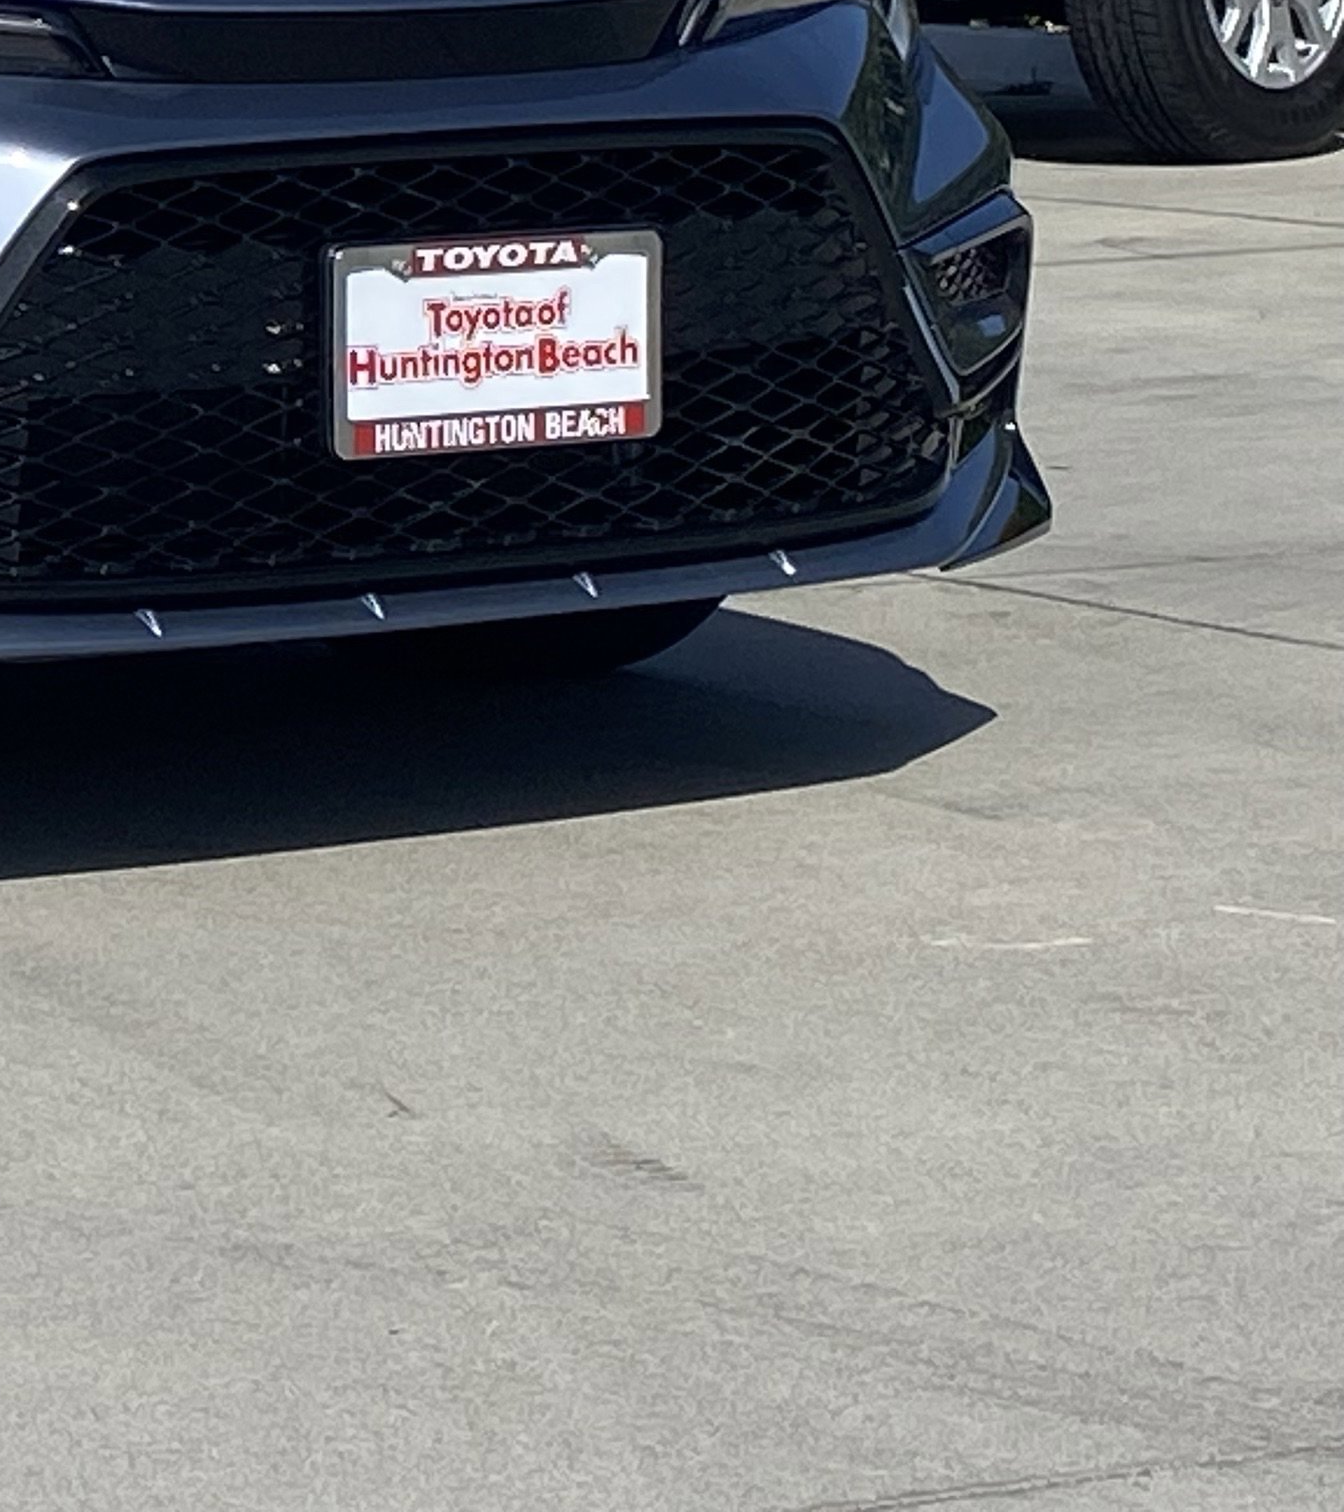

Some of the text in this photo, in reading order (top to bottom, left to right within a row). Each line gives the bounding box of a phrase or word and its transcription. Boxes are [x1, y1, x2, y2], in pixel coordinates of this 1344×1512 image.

[416, 240, 578, 272] TOYOTA
[426, 290, 569, 341] Toyota of
[349, 329, 639, 384] Huntington Beach
[374, 406, 627, 454] HUNTINGTON BEACH
